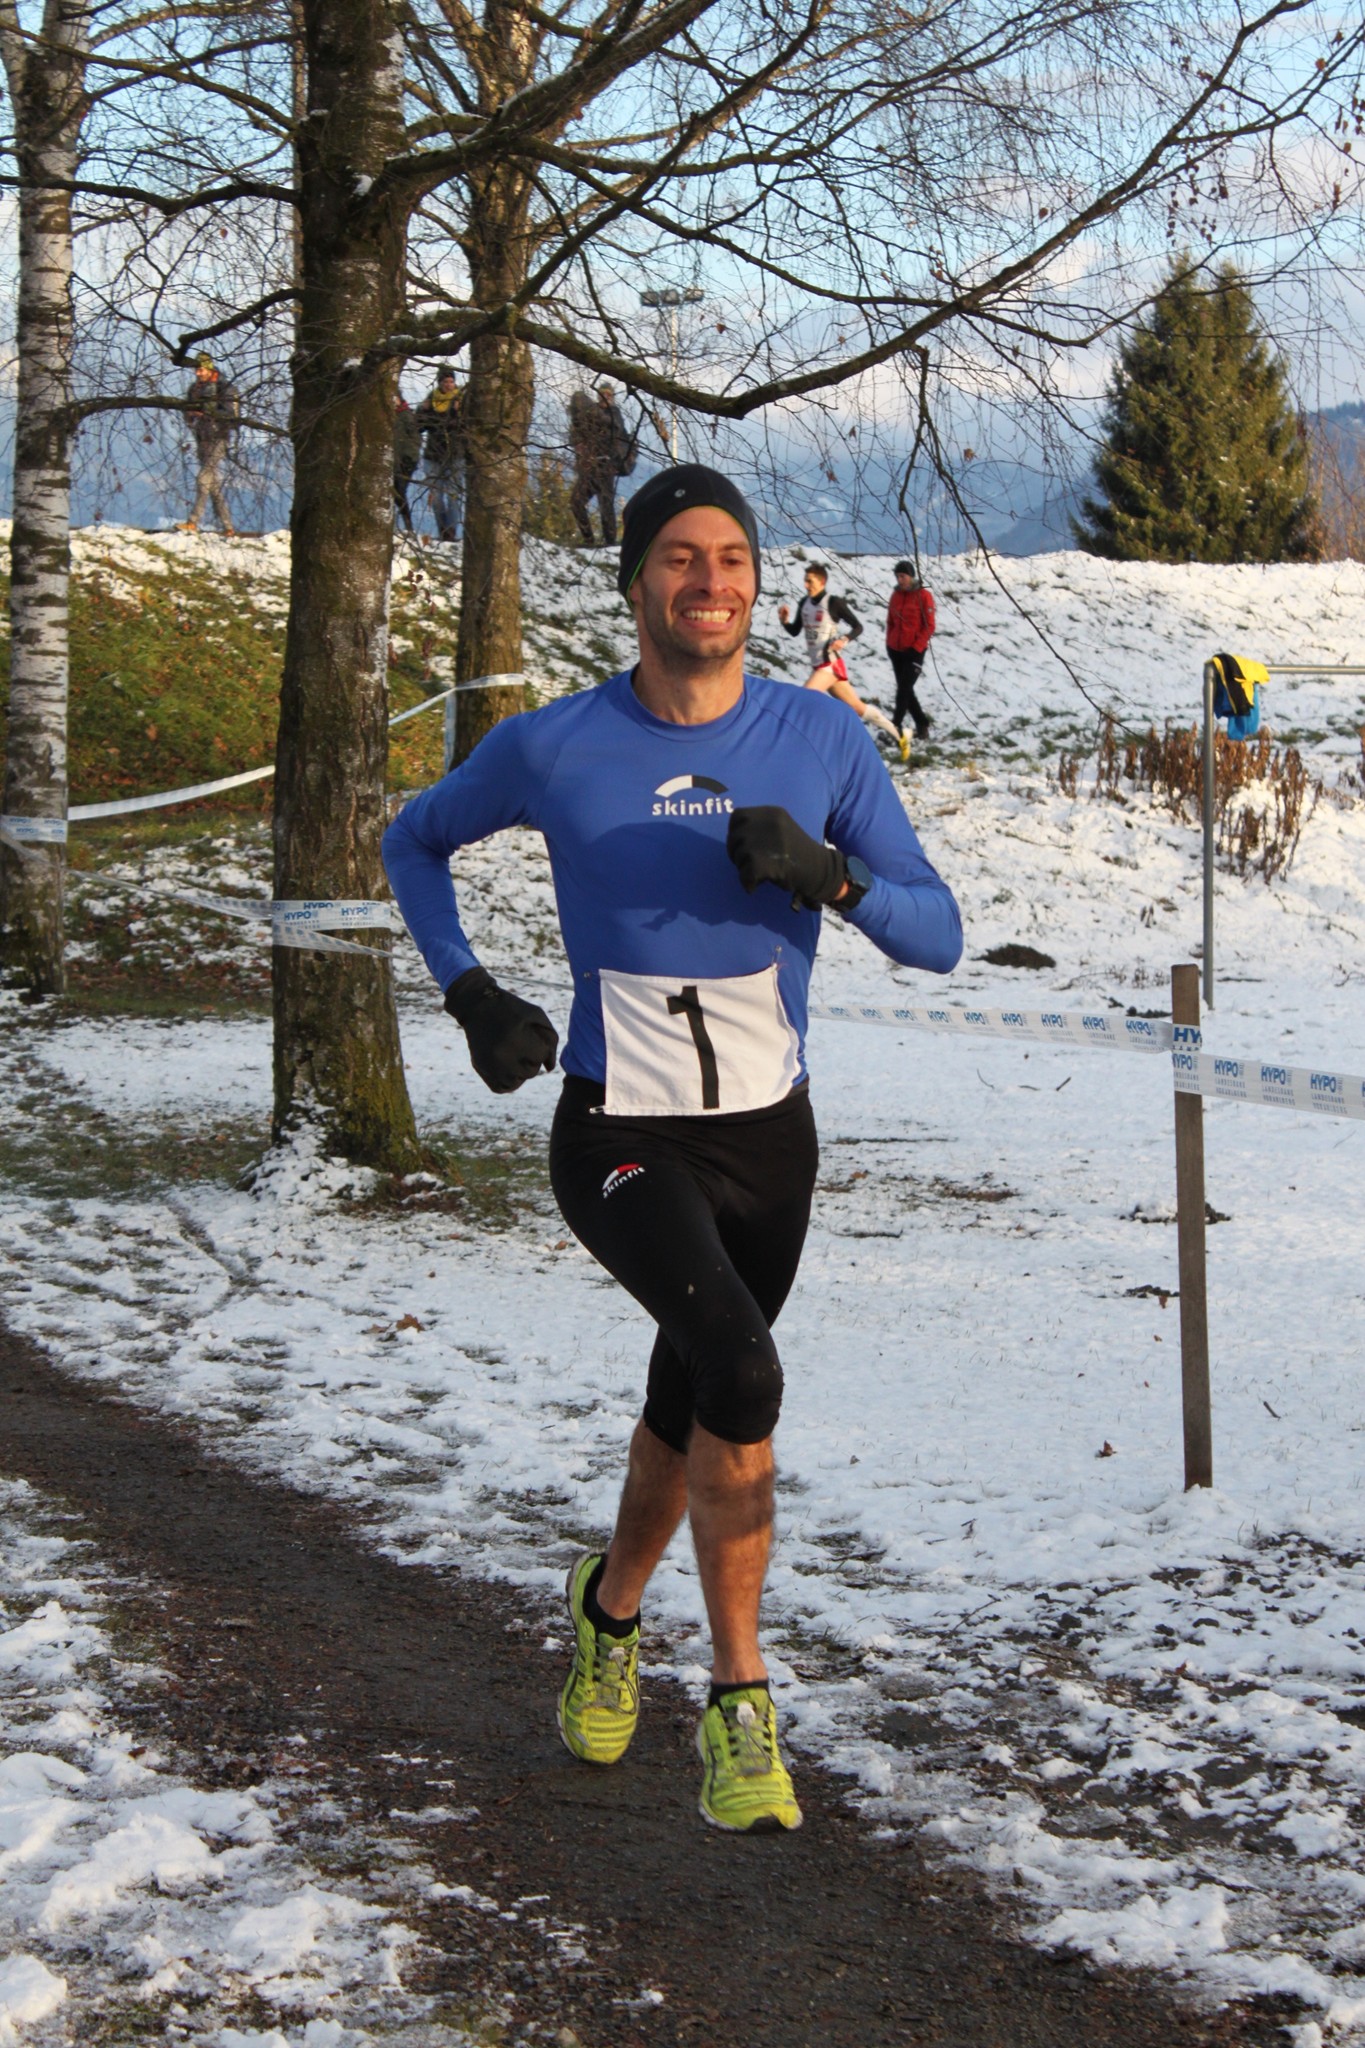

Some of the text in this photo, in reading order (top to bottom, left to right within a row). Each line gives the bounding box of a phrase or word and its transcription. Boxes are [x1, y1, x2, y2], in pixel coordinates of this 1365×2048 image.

[652, 798, 734, 816] skinfit
[284, 911, 311, 921] HYPO
[341, 906, 369, 916] HYPO
[927, 1010, 950, 1023] HYPO
[963, 1012, 986, 1025] HYPO
[1001, 1013, 1024, 1026] HYPO
[1041, 1014, 1064, 1028] HYPO
[1082, 1016, 1106, 1031] HYPO
[1126, 1020, 1152, 1035] HYPO
[666, 985, 720, 1110] 1
[1214, 1059, 1239, 1078] HYPO
[1261, 1065, 1286, 1085] HYPO
[1310, 1073, 1337, 1093] HYPO
[602, 1166, 645, 1198] skinfit
